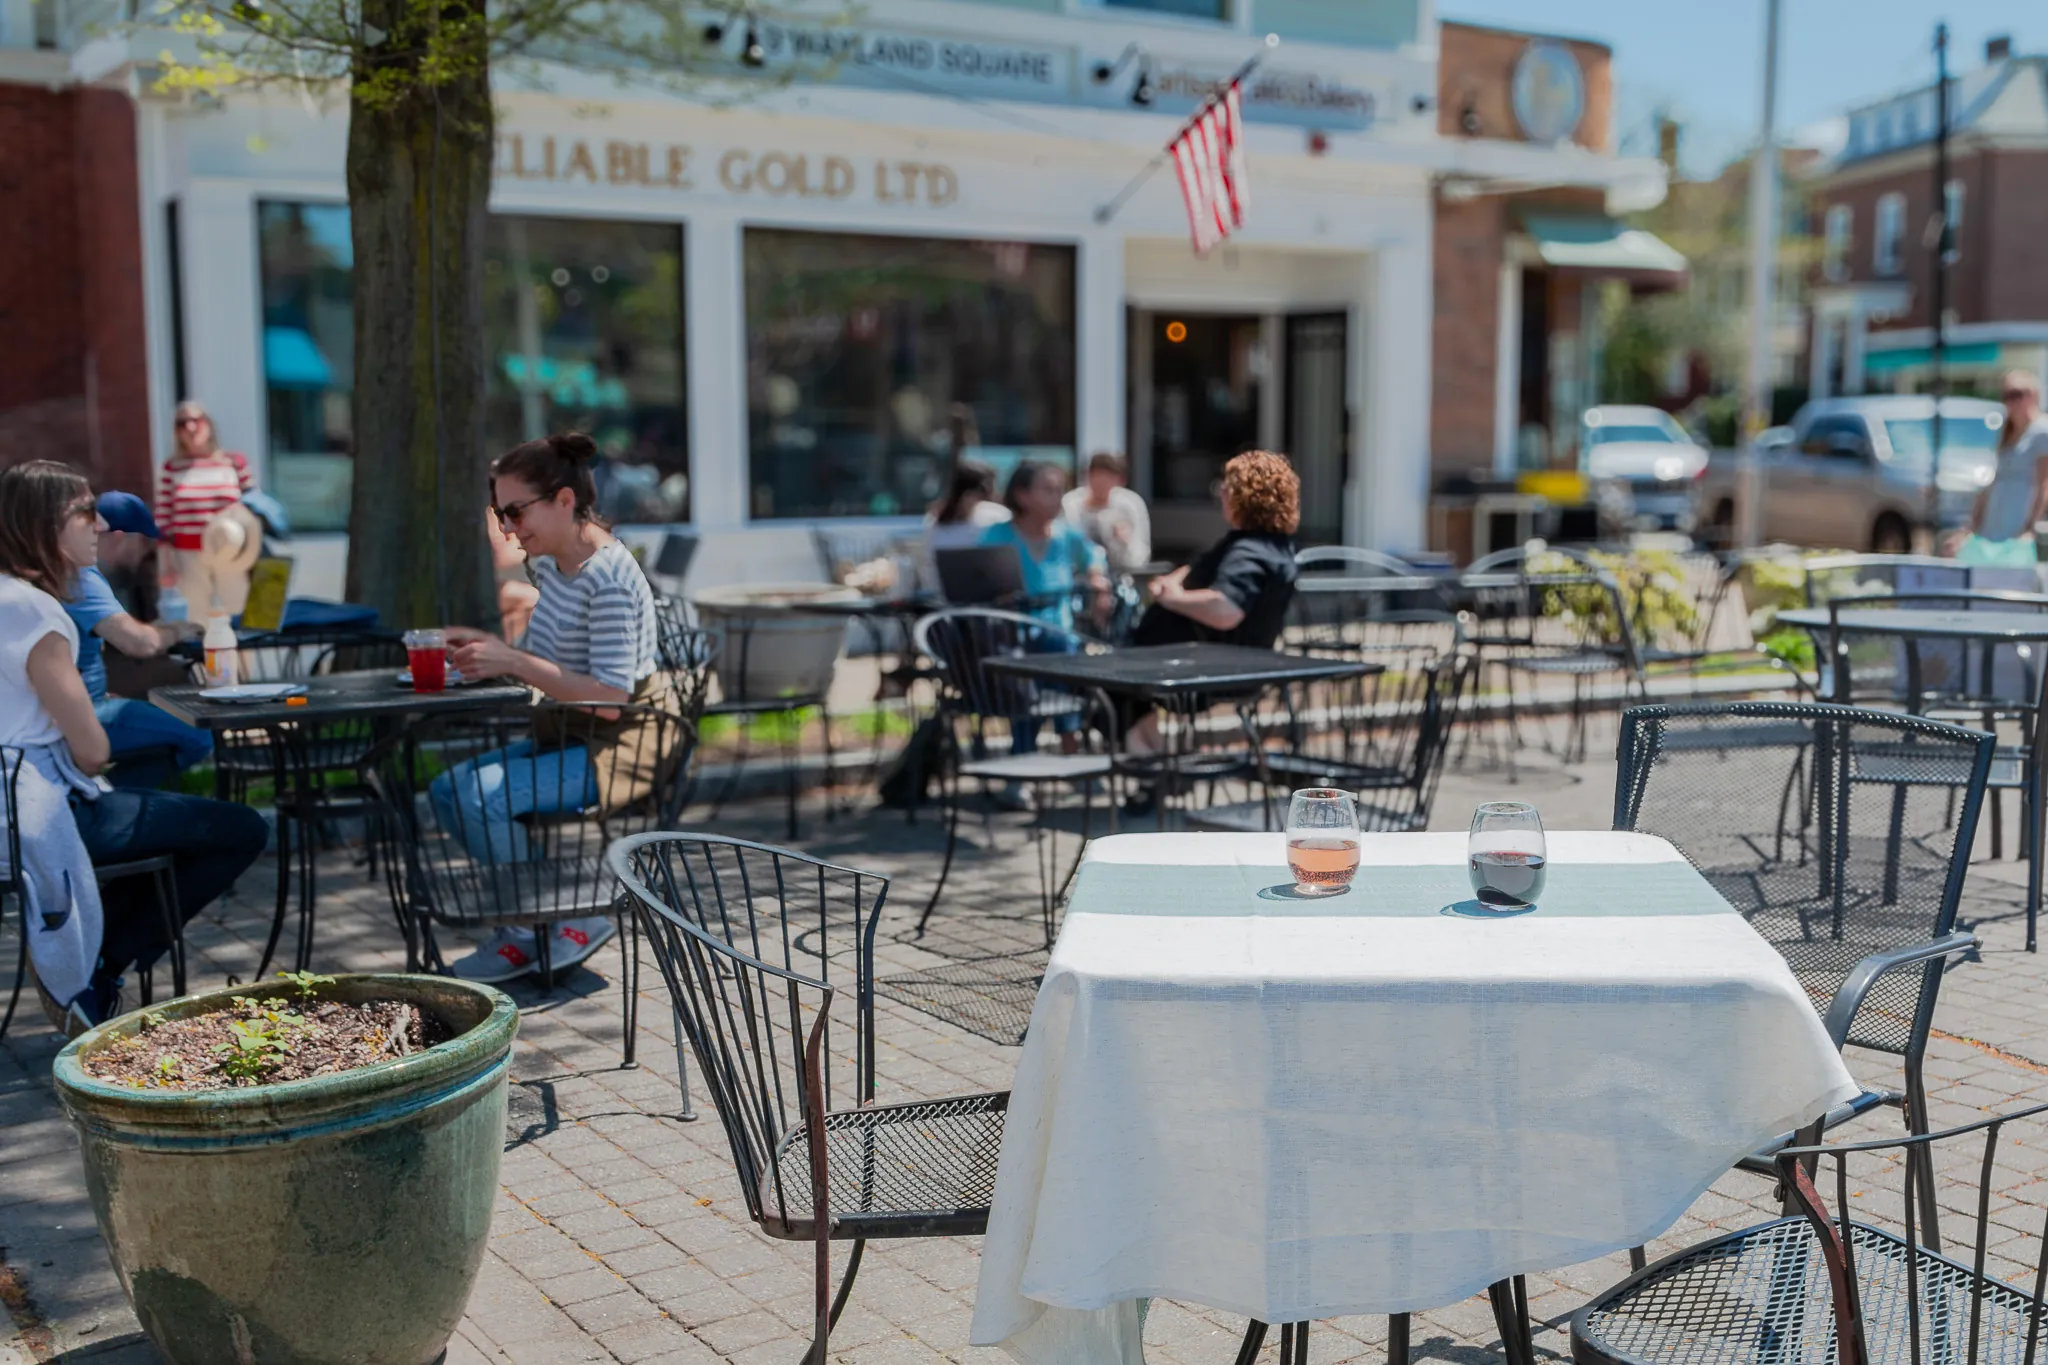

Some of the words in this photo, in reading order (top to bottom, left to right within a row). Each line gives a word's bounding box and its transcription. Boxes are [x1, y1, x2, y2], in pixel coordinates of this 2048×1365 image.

[938, 41, 1053, 83] SQUARE
[717, 146, 855, 199] GOLD
[874, 157, 959, 208] LTD
